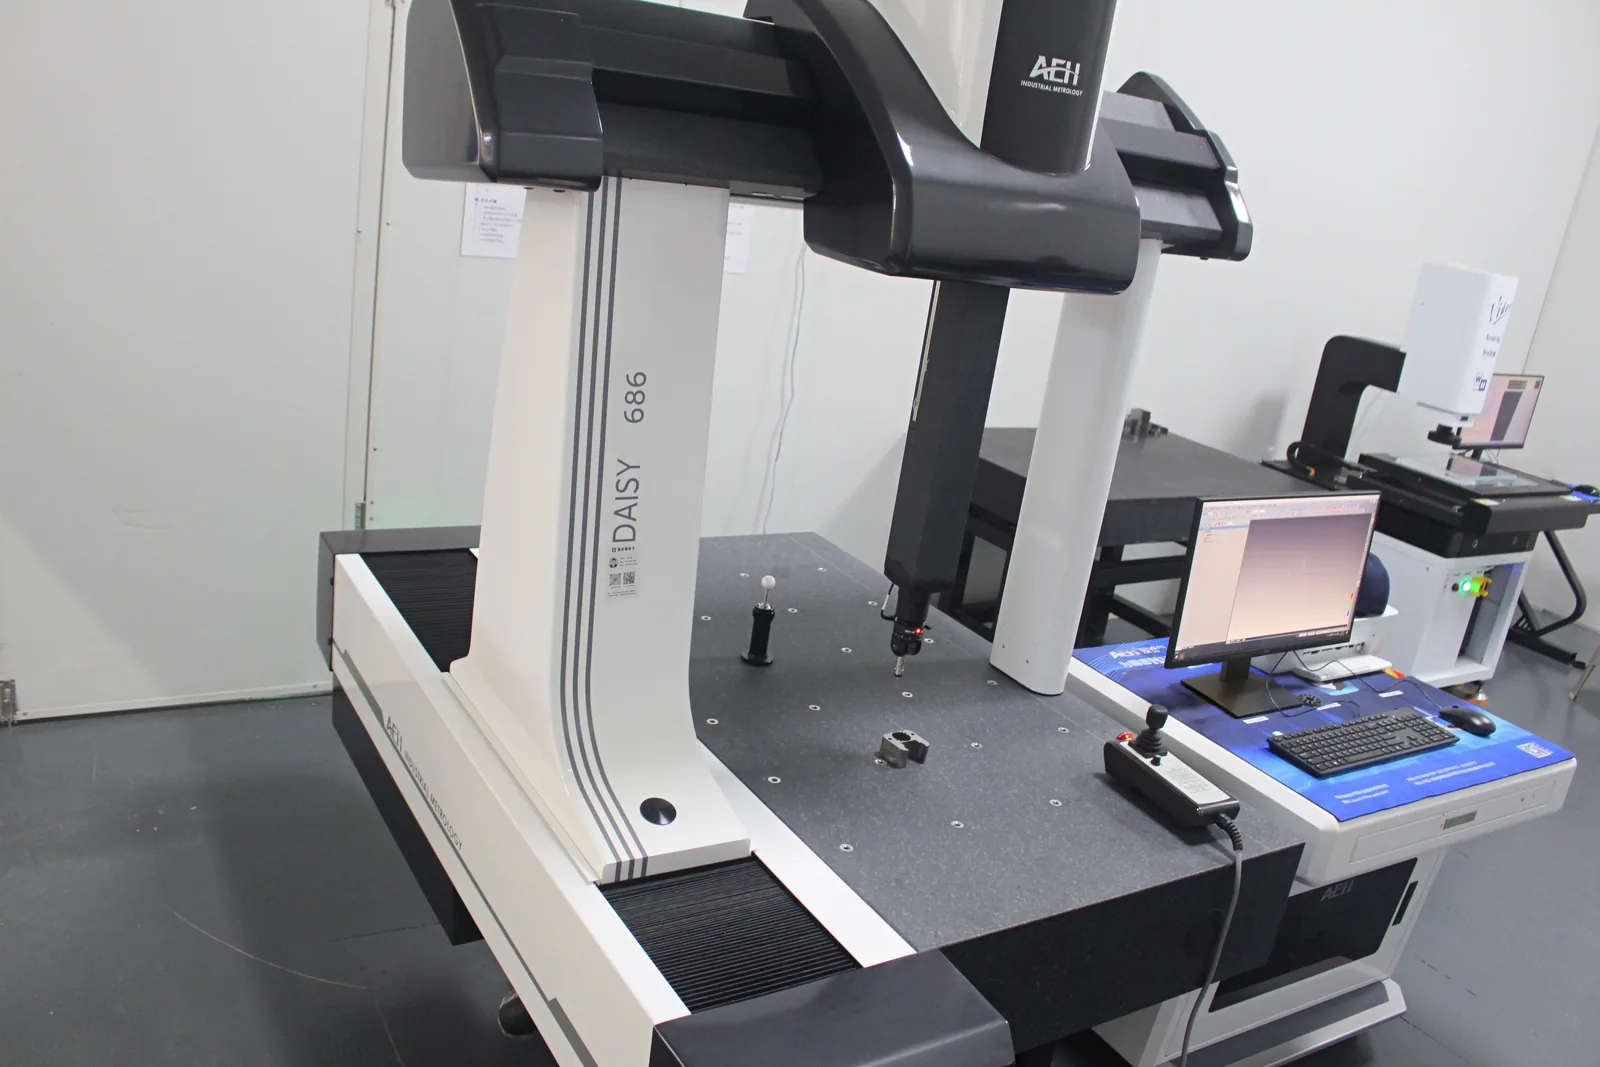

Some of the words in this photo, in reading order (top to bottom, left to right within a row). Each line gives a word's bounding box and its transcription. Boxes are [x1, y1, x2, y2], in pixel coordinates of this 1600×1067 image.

[1020, 80, 1052, 92] INDUSTRIAL
[1053, 85, 1083, 97] METROLOGY
[1029, 55, 1081, 86] AEH
[623, 371, 647, 424] 686
[612, 458, 641, 543] DAISY
[404, 748, 430, 798] INDUSTRIAL
[430, 793, 463, 851] METROLOGY
